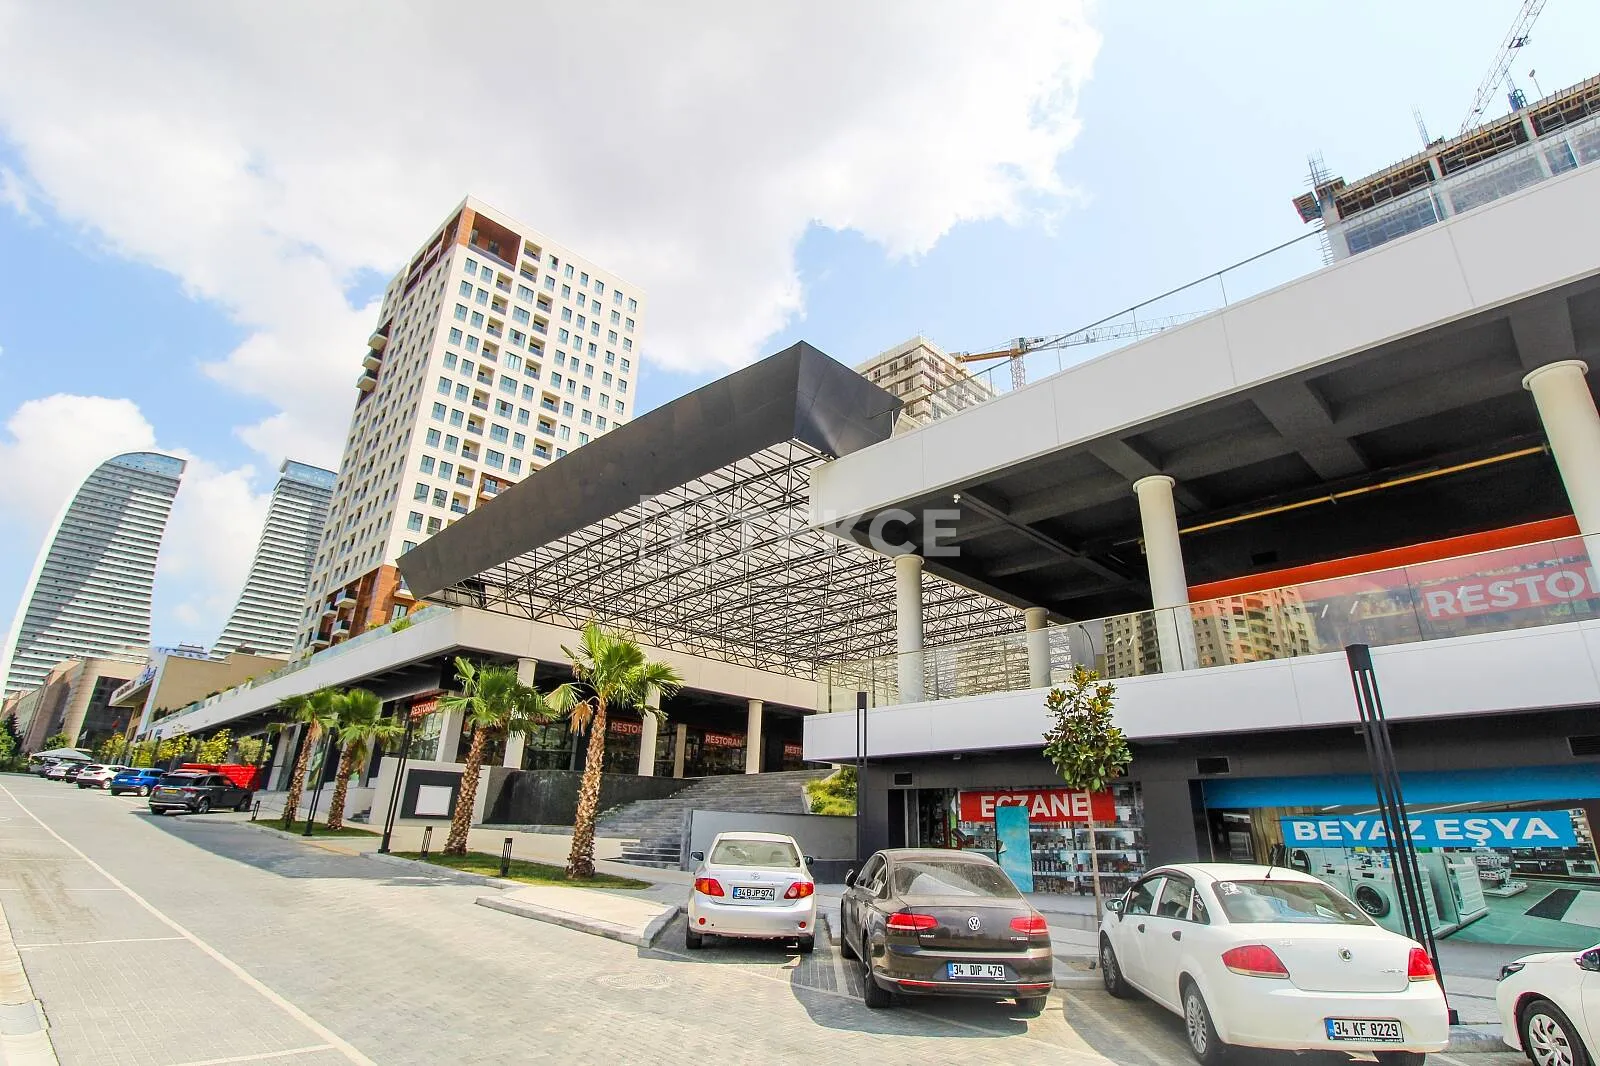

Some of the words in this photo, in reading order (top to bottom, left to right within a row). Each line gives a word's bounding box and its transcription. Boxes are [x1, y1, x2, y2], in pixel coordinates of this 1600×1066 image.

[705, 733, 742, 747] RESTORAN
[1433, 817, 1560, 846] EŞYA
[953, 964, 964, 975] 34
[970, 965, 982, 975] DIP
[988, 966, 1003, 976] 479
[1334, 1022, 1349, 1035] 34
[1353, 1022, 1366, 1036] KF
[1370, 1023, 1399, 1037] 8229
